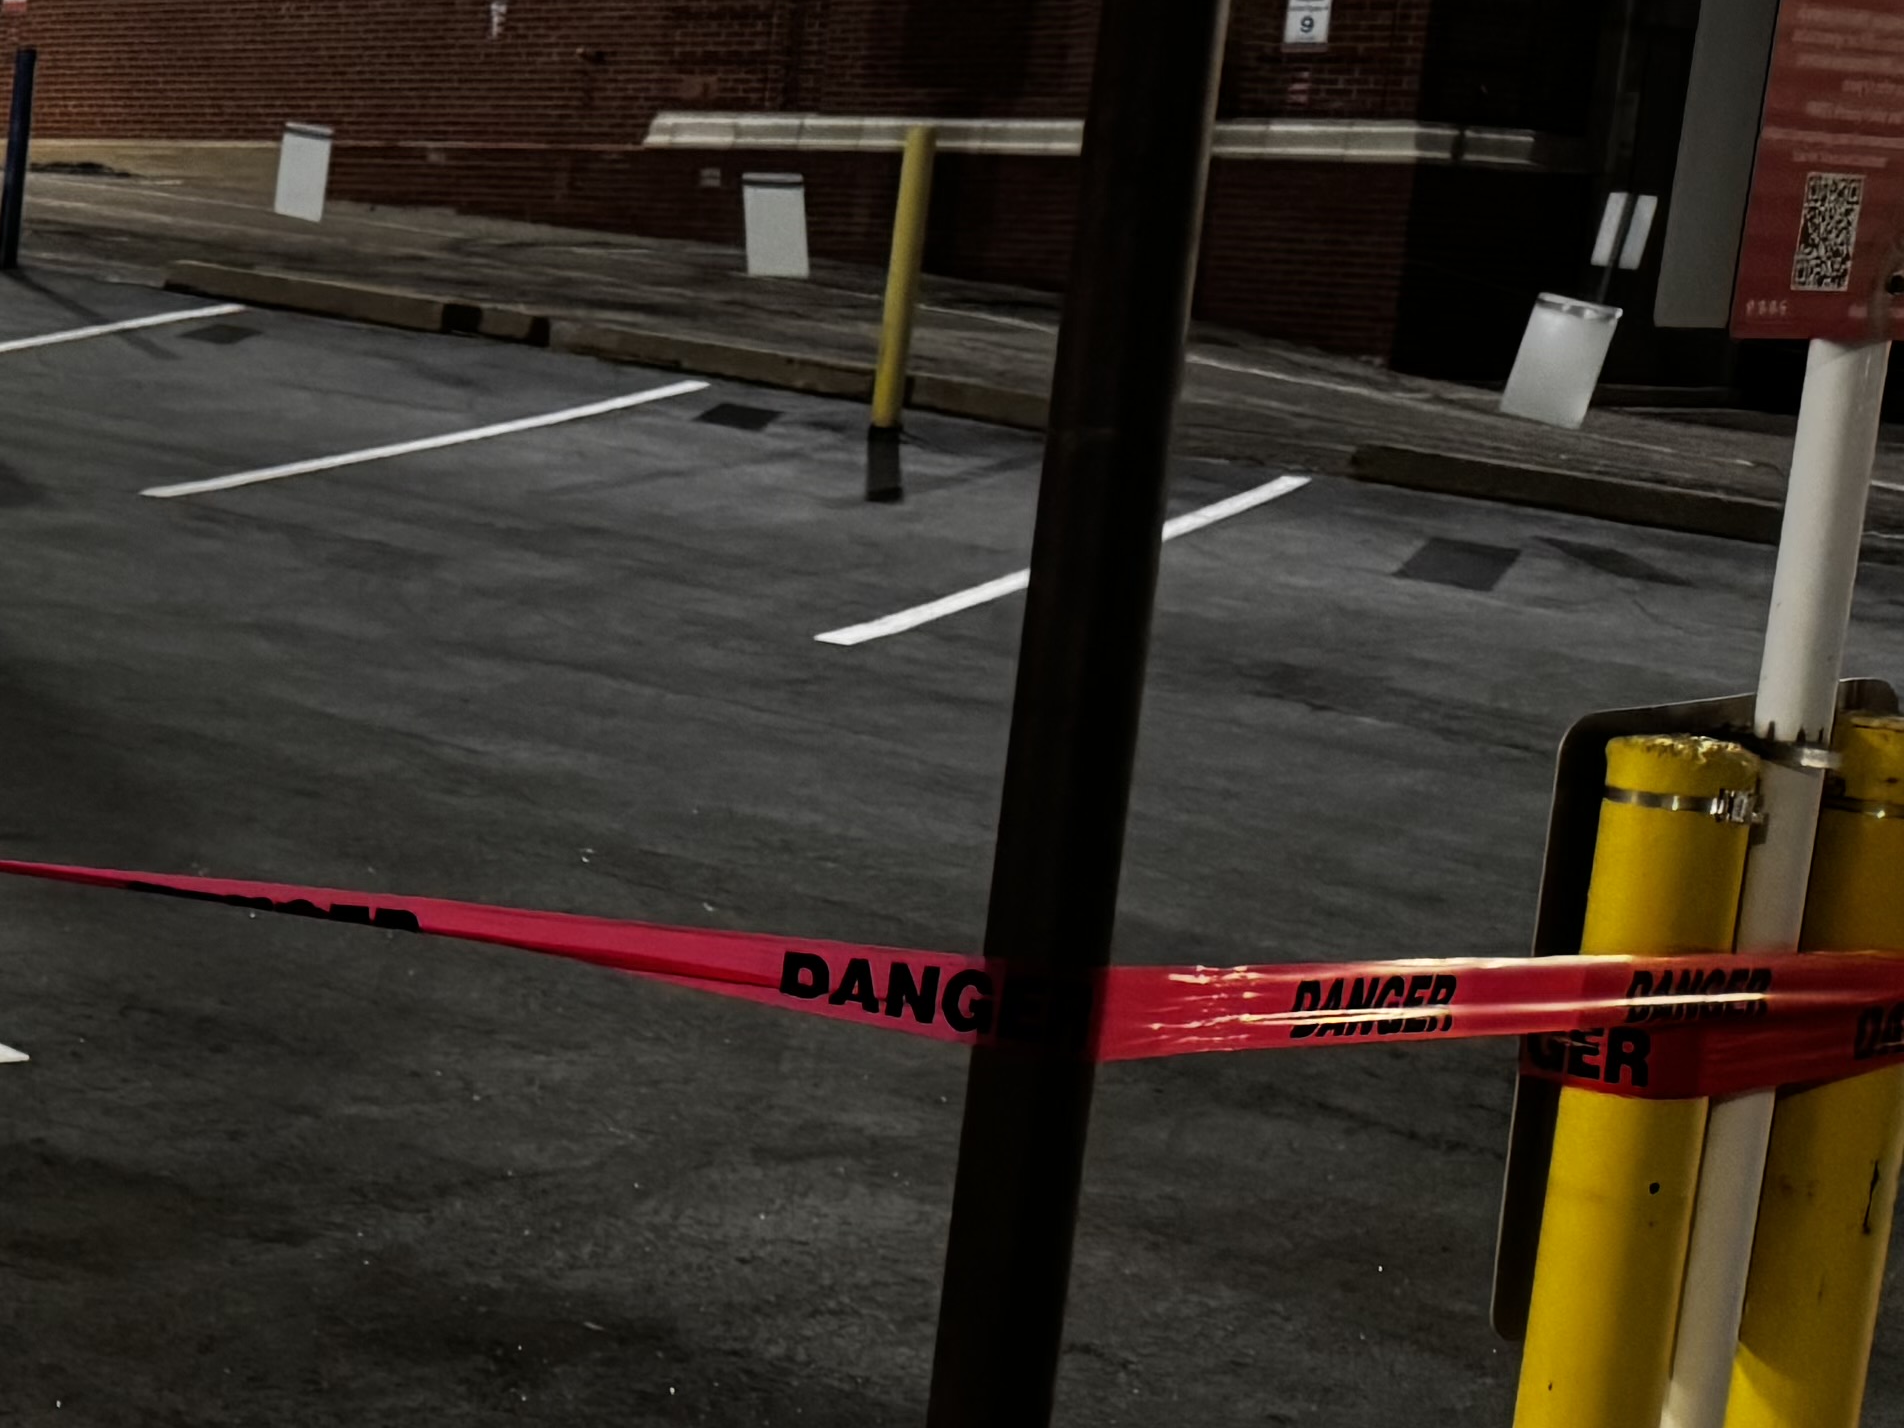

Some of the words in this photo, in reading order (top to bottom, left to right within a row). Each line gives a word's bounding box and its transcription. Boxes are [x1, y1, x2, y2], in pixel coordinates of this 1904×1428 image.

[1299, 15, 1314, 33] 9
[779, 950, 993, 1033] DANG
[1289, 974, 1457, 1040] DANGER
[1625, 968, 1774, 1024] DANGER
